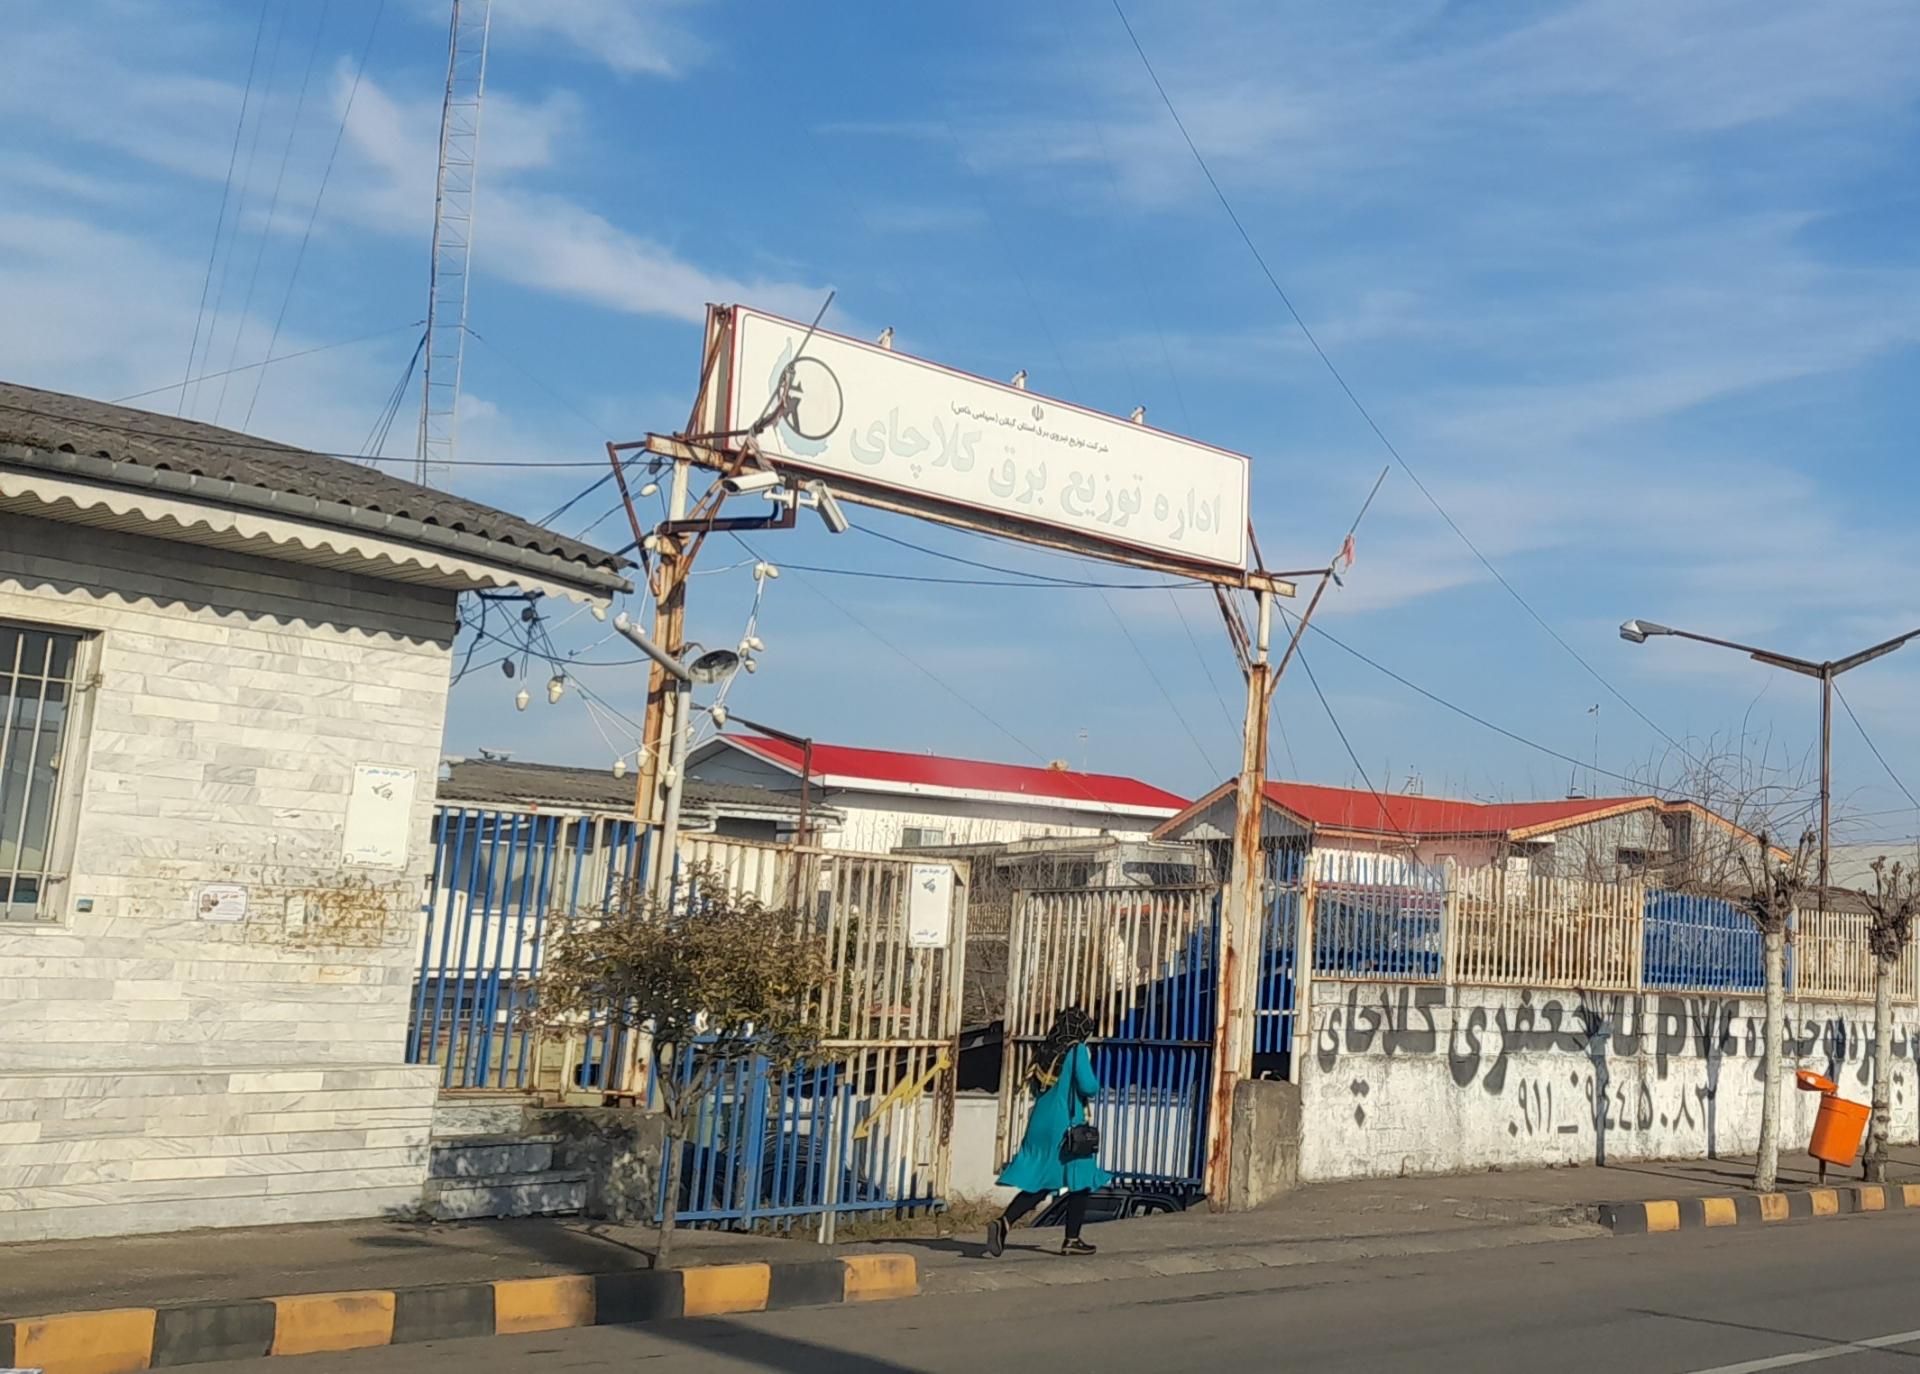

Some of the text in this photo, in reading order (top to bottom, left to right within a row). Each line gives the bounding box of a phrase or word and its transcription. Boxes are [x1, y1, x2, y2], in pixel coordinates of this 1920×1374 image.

[999, 416, 1017, 427] گیلان
[1017, 421, 1036, 432] استان
[1036, 428, 1049, 439] برق
[1049, 432, 1069, 443] نیروی
[1069, 436, 1086, 449] توزیع
[1086, 441, 1109, 453] شرکت
[850, 406, 1221, 541] اداره توزیع برق کلاچای
[1449, 987, 1604, 1096] جعفری
[1317, 986, 1447, 1129] کلاچای
